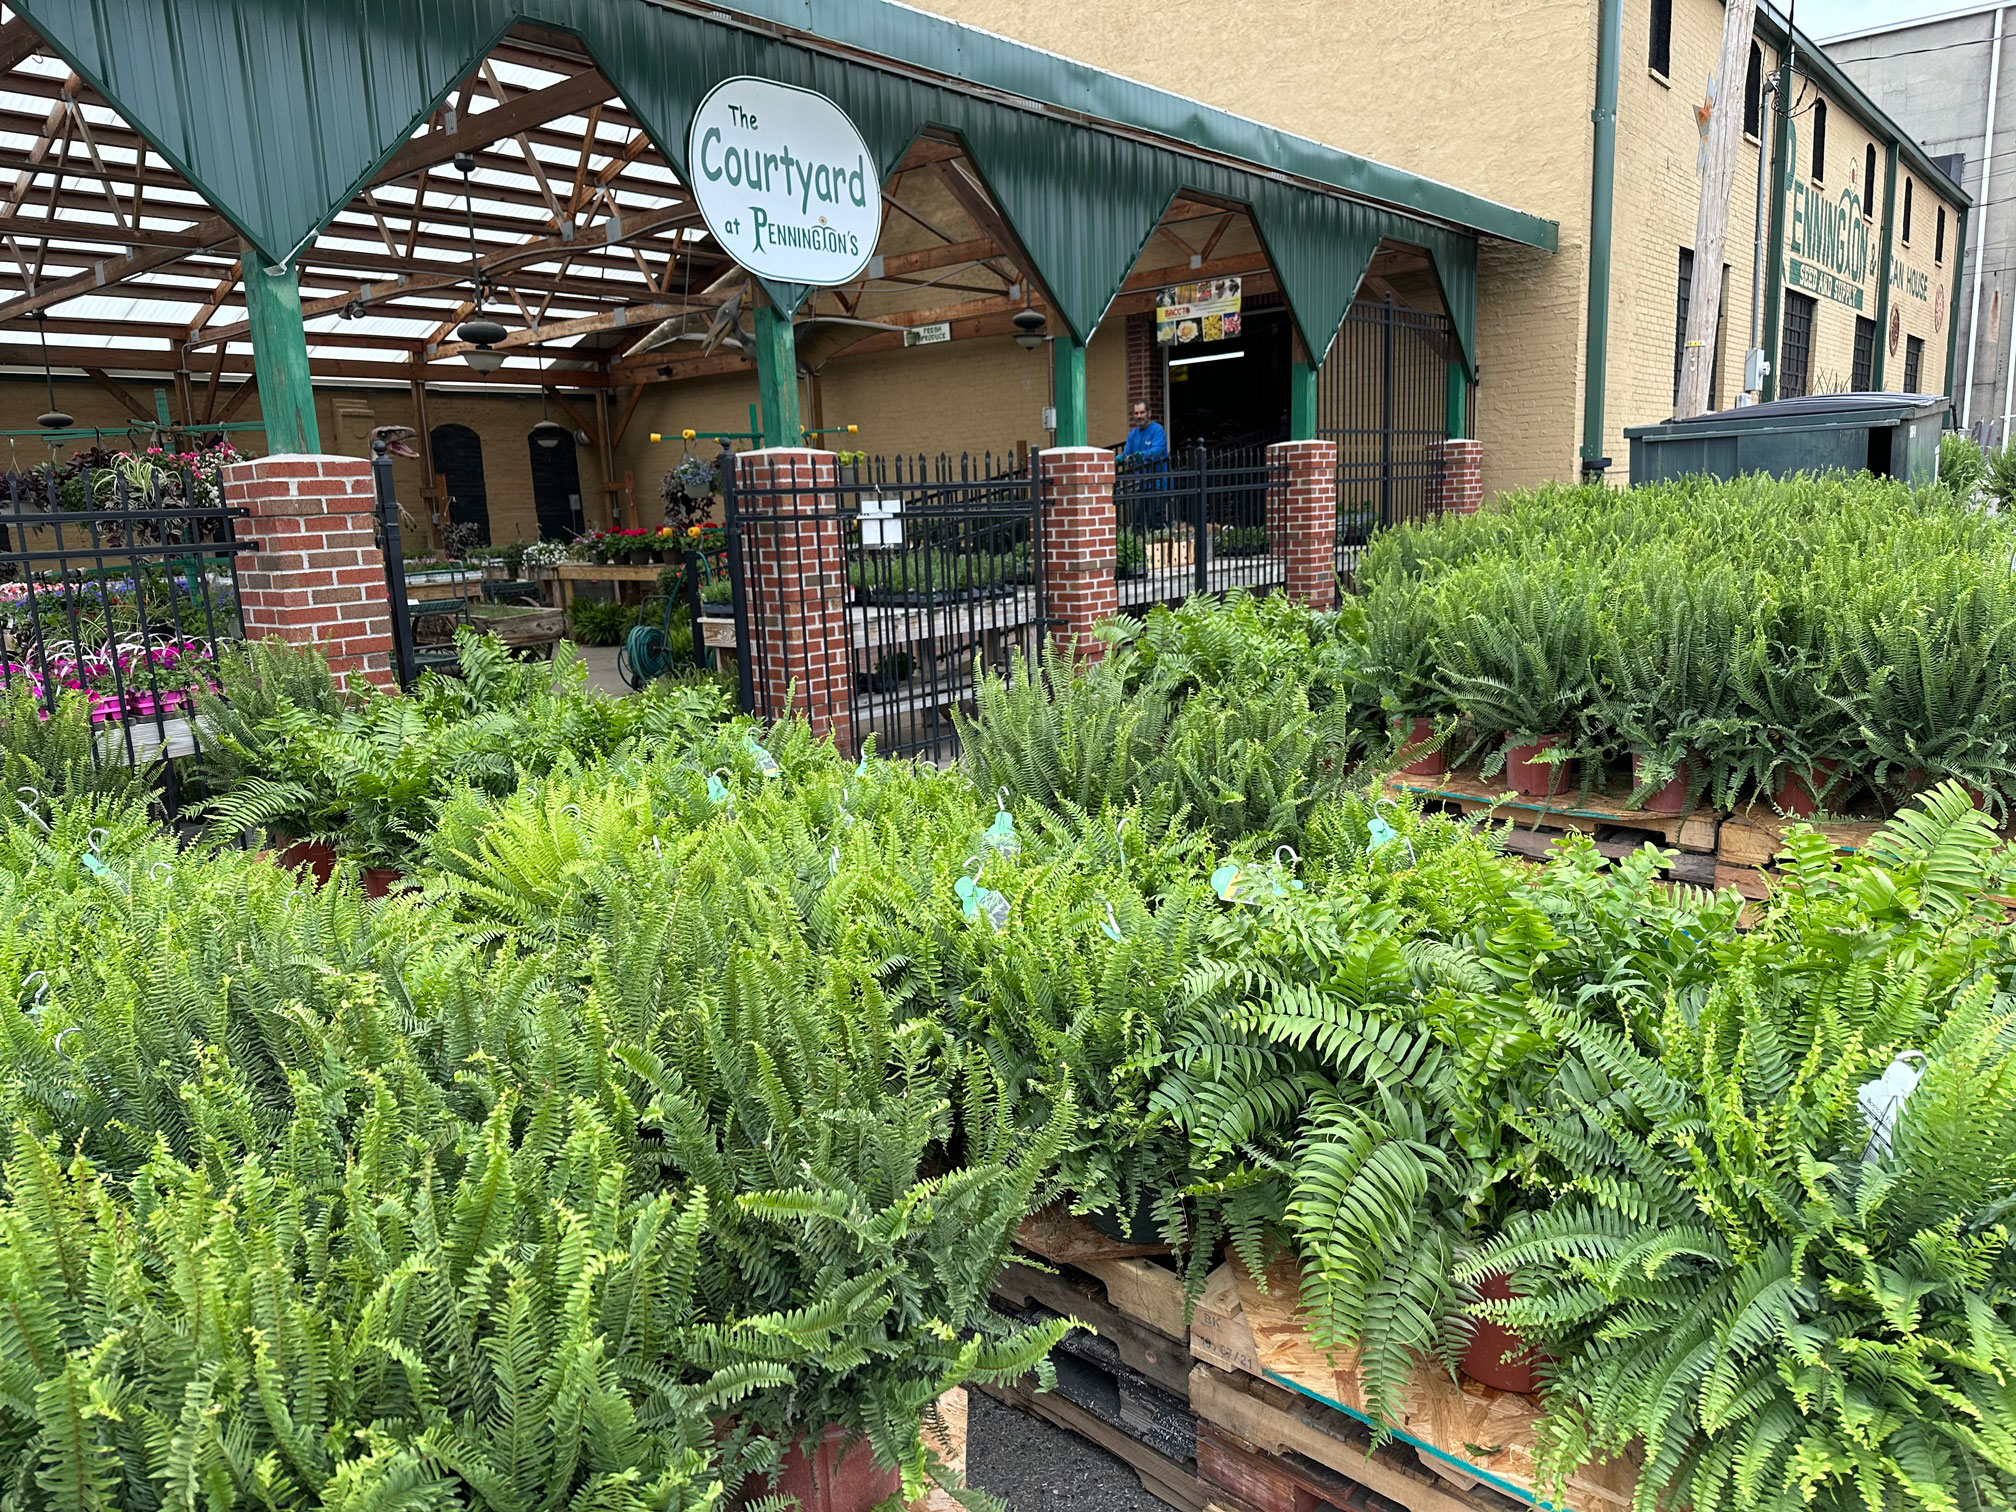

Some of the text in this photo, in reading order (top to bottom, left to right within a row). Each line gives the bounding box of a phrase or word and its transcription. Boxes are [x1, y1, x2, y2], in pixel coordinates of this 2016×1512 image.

[728, 104, 758, 130] The
[701, 127, 866, 215] Courtyard
[724, 218, 741, 235] at
[1869, 243, 1877, 277] &
[1800, 263, 1858, 308] SEED AND SUPPLY
[1906, 265, 1928, 302] HOUSE
[920, 332, 946, 342] PRODUCE
[923, 326, 942, 336] FRESH
[1203, 1312, 1222, 1330] BK
